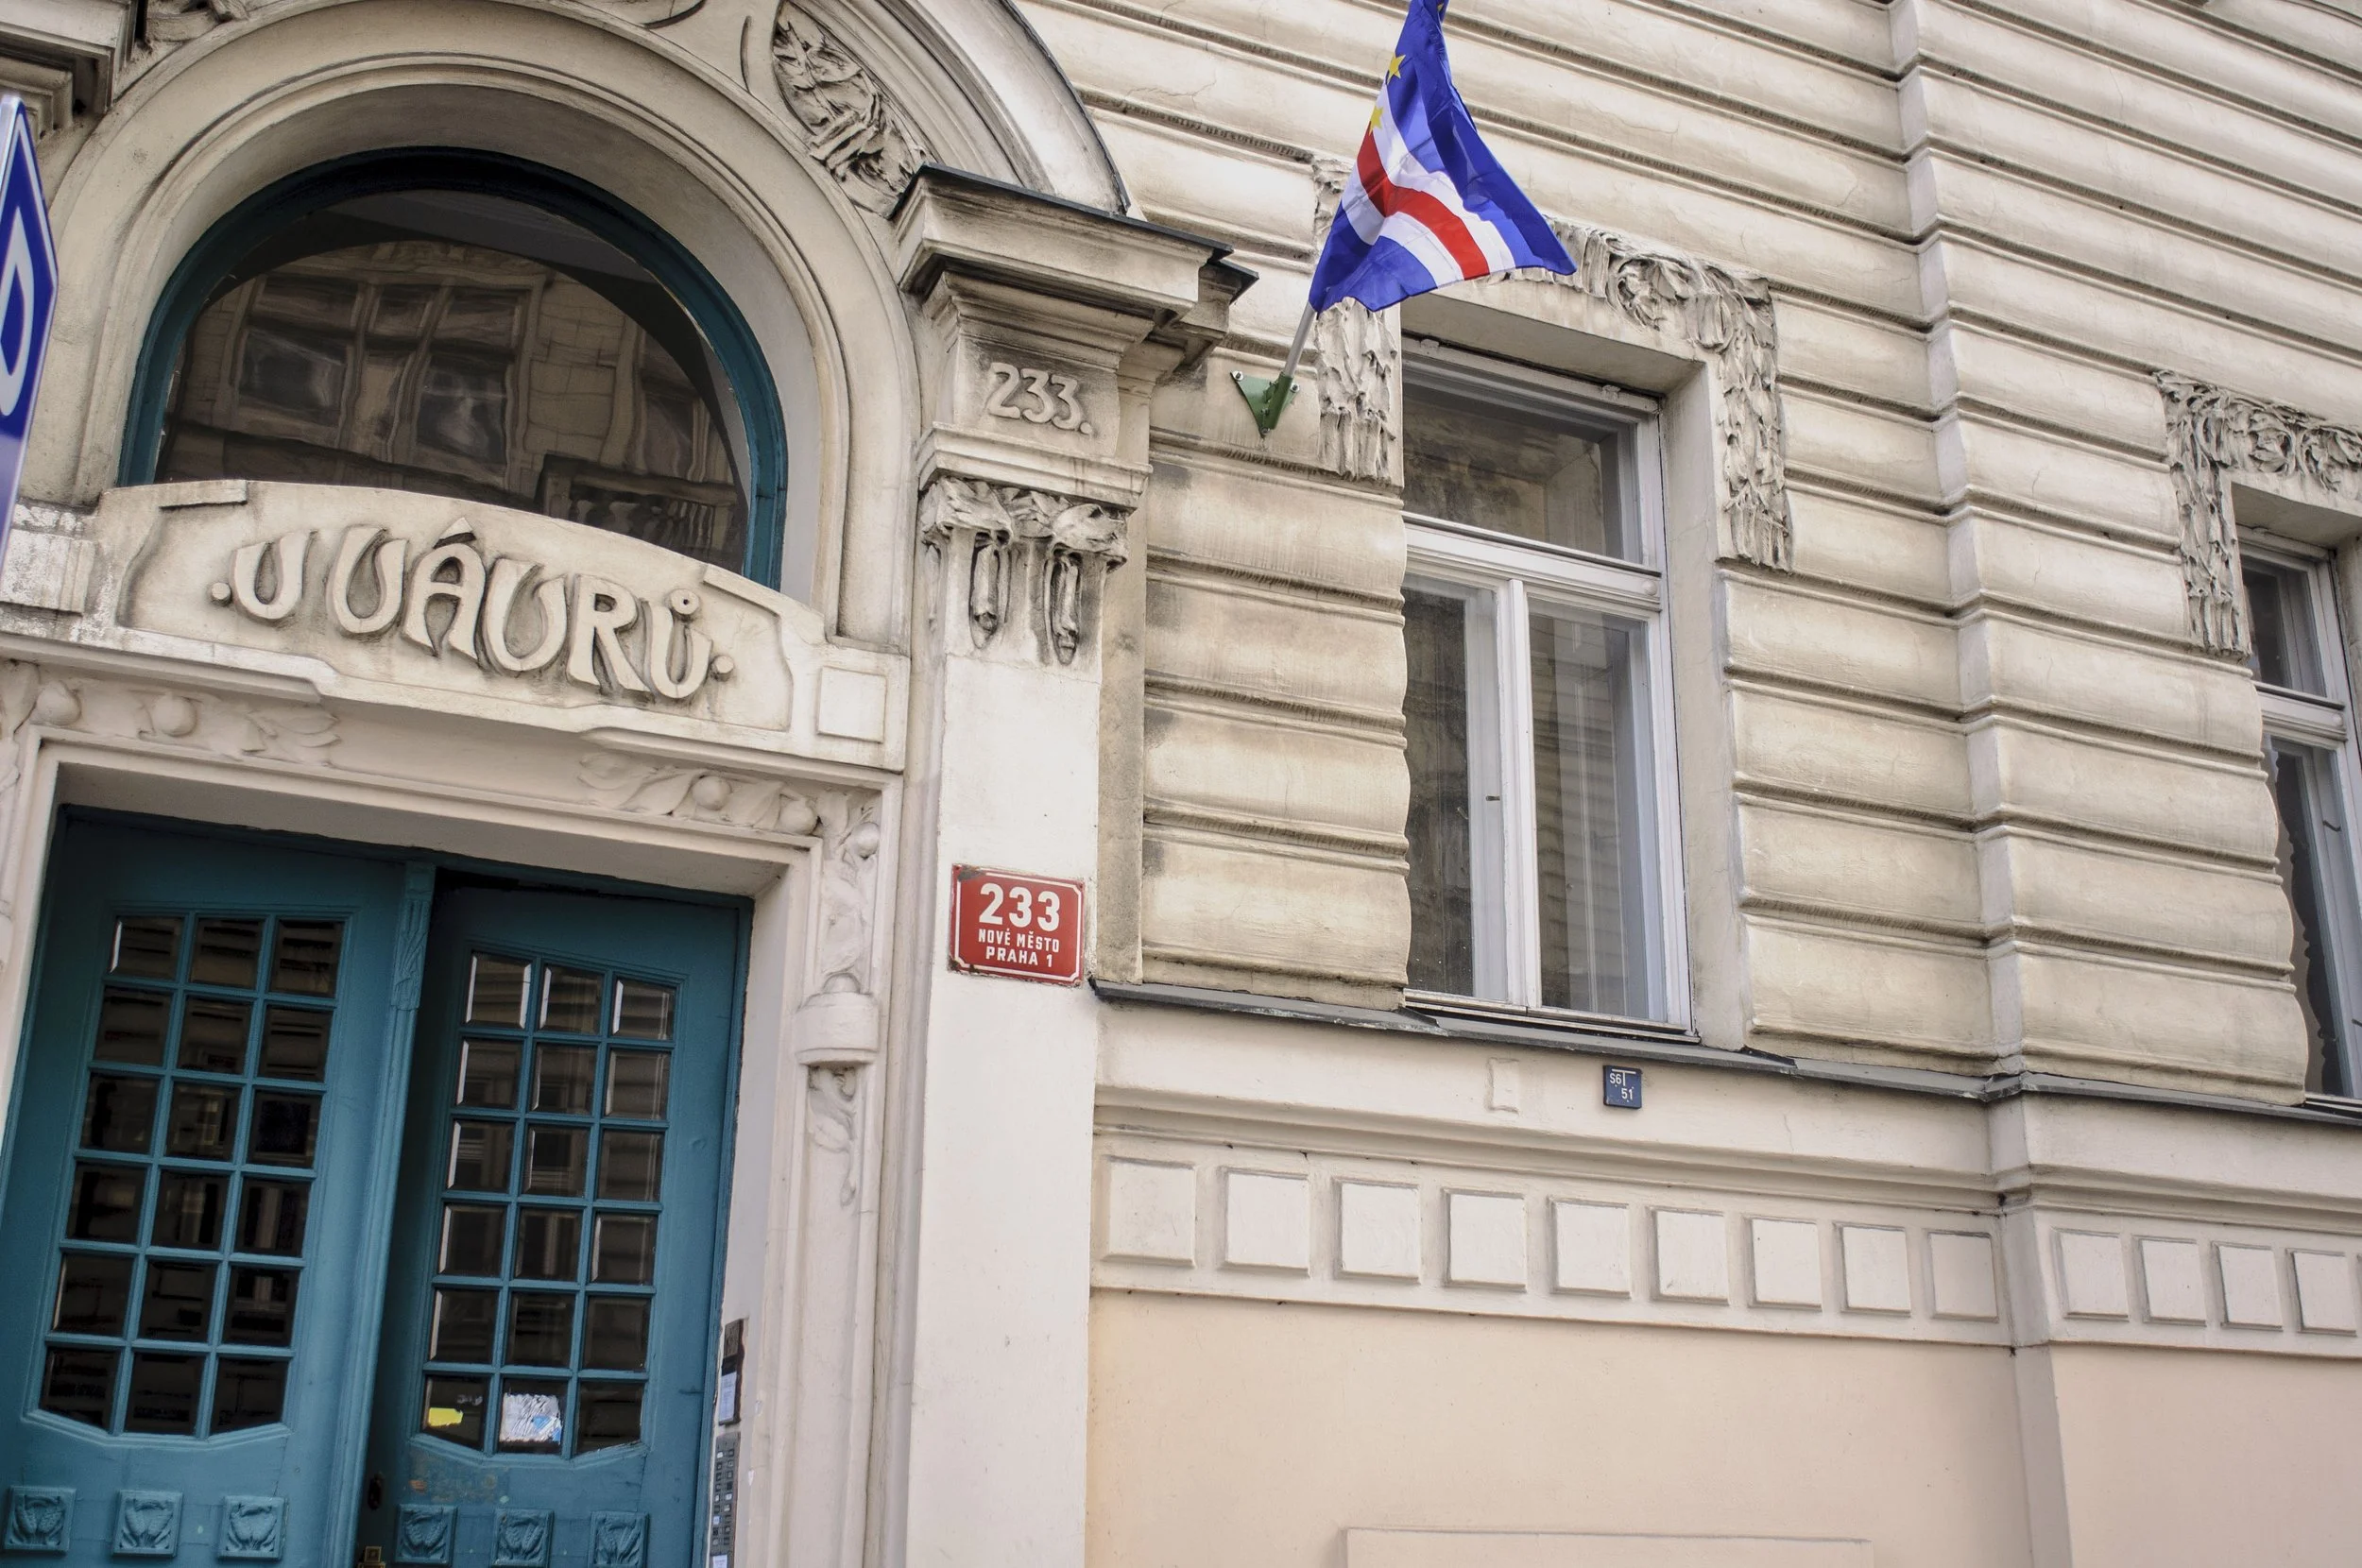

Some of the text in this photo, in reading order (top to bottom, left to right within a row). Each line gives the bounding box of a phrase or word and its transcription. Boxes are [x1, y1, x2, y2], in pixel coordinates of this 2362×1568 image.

[230, 530, 310, 621] U
[978, 882, 1061, 932] 233
[978, 928, 1060, 953] NOVÉ MĚSTO
[985, 946, 1053, 968] PRAHA 1
